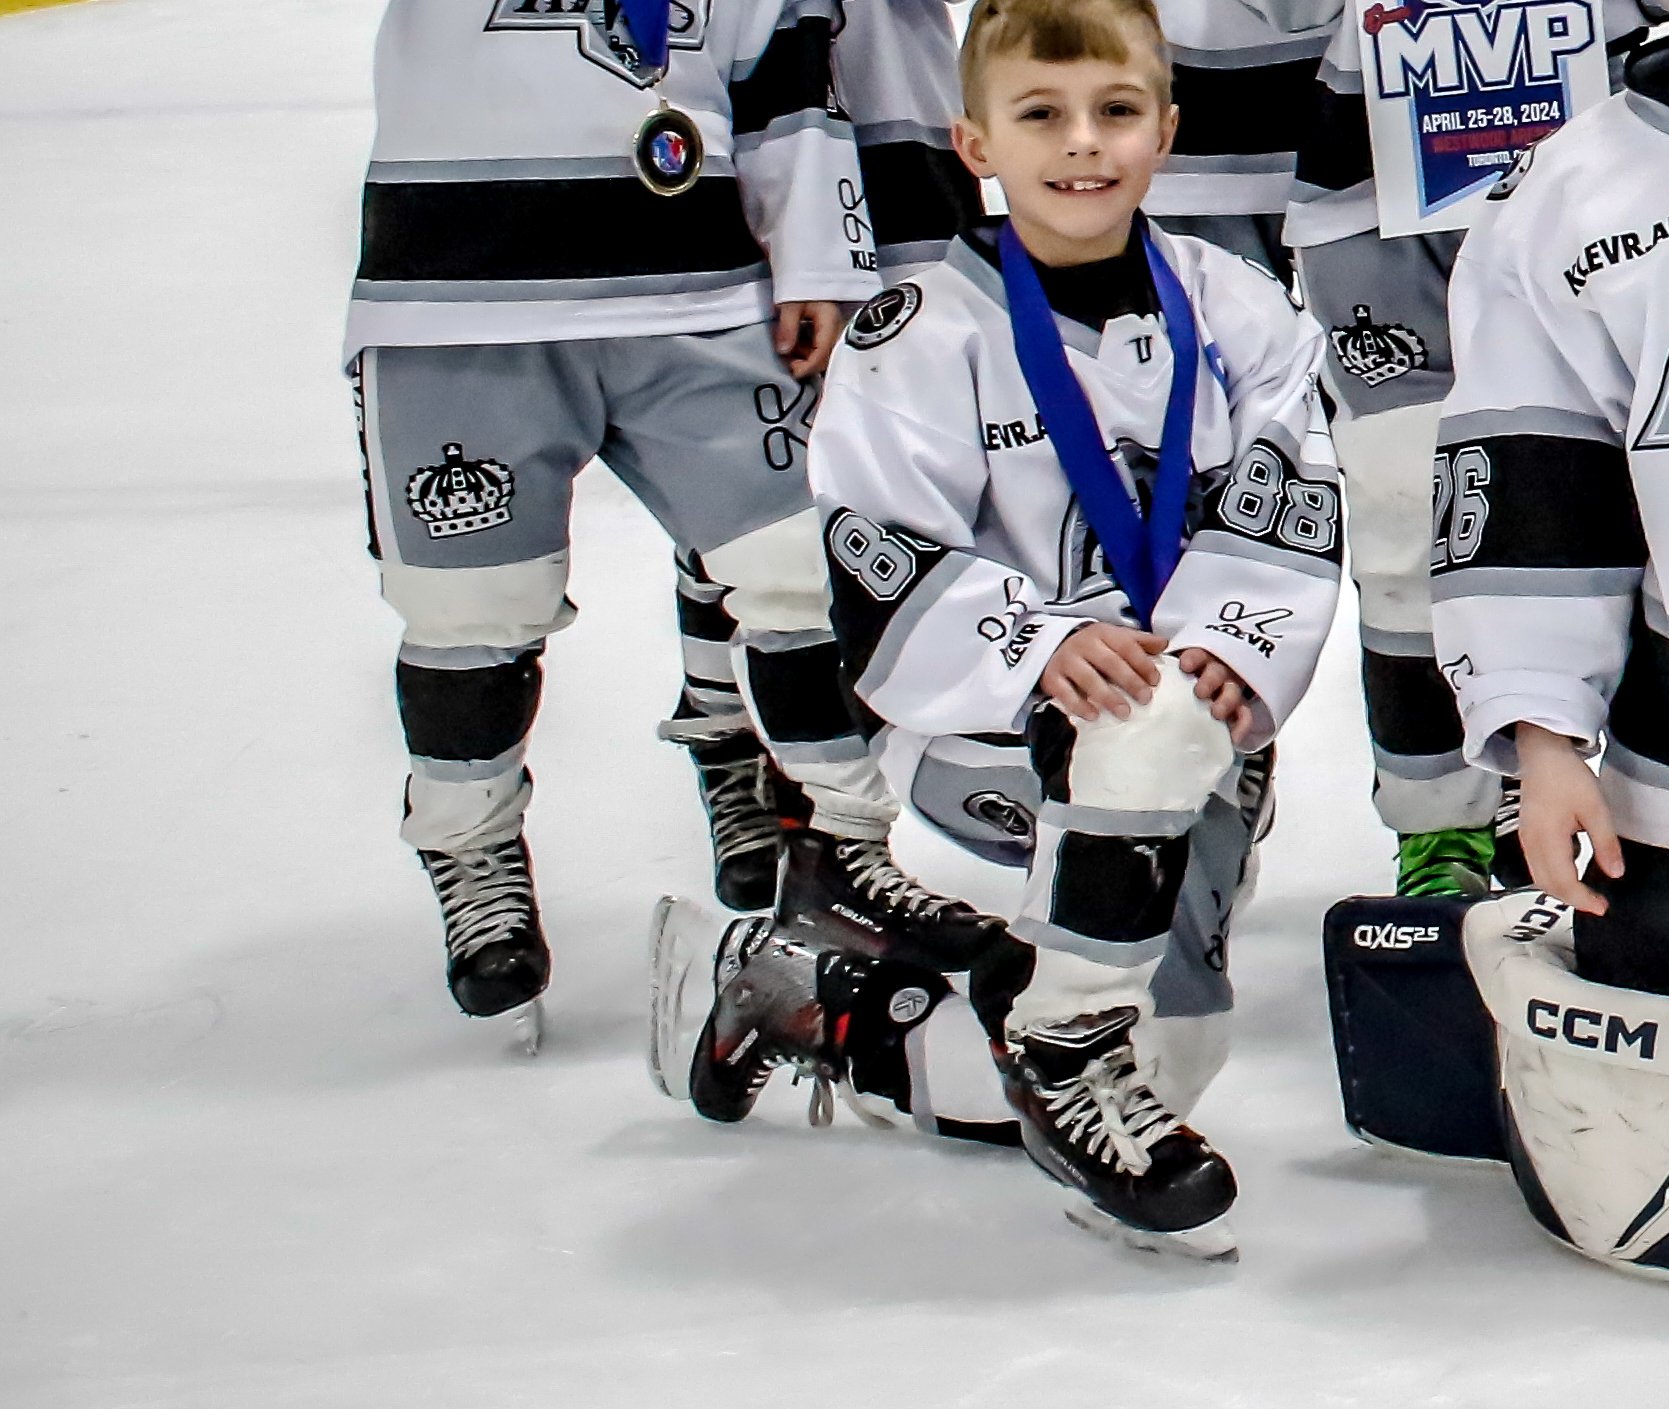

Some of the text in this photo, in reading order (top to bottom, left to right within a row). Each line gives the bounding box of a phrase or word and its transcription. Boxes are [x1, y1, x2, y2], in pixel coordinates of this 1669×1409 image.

[1422, 101, 1561, 133] APRIL 25-28, 2024
[849, 248, 877, 271] KLE
[1217, 443, 1338, 552] 88
[1527, 998, 1659, 1060] CCM
